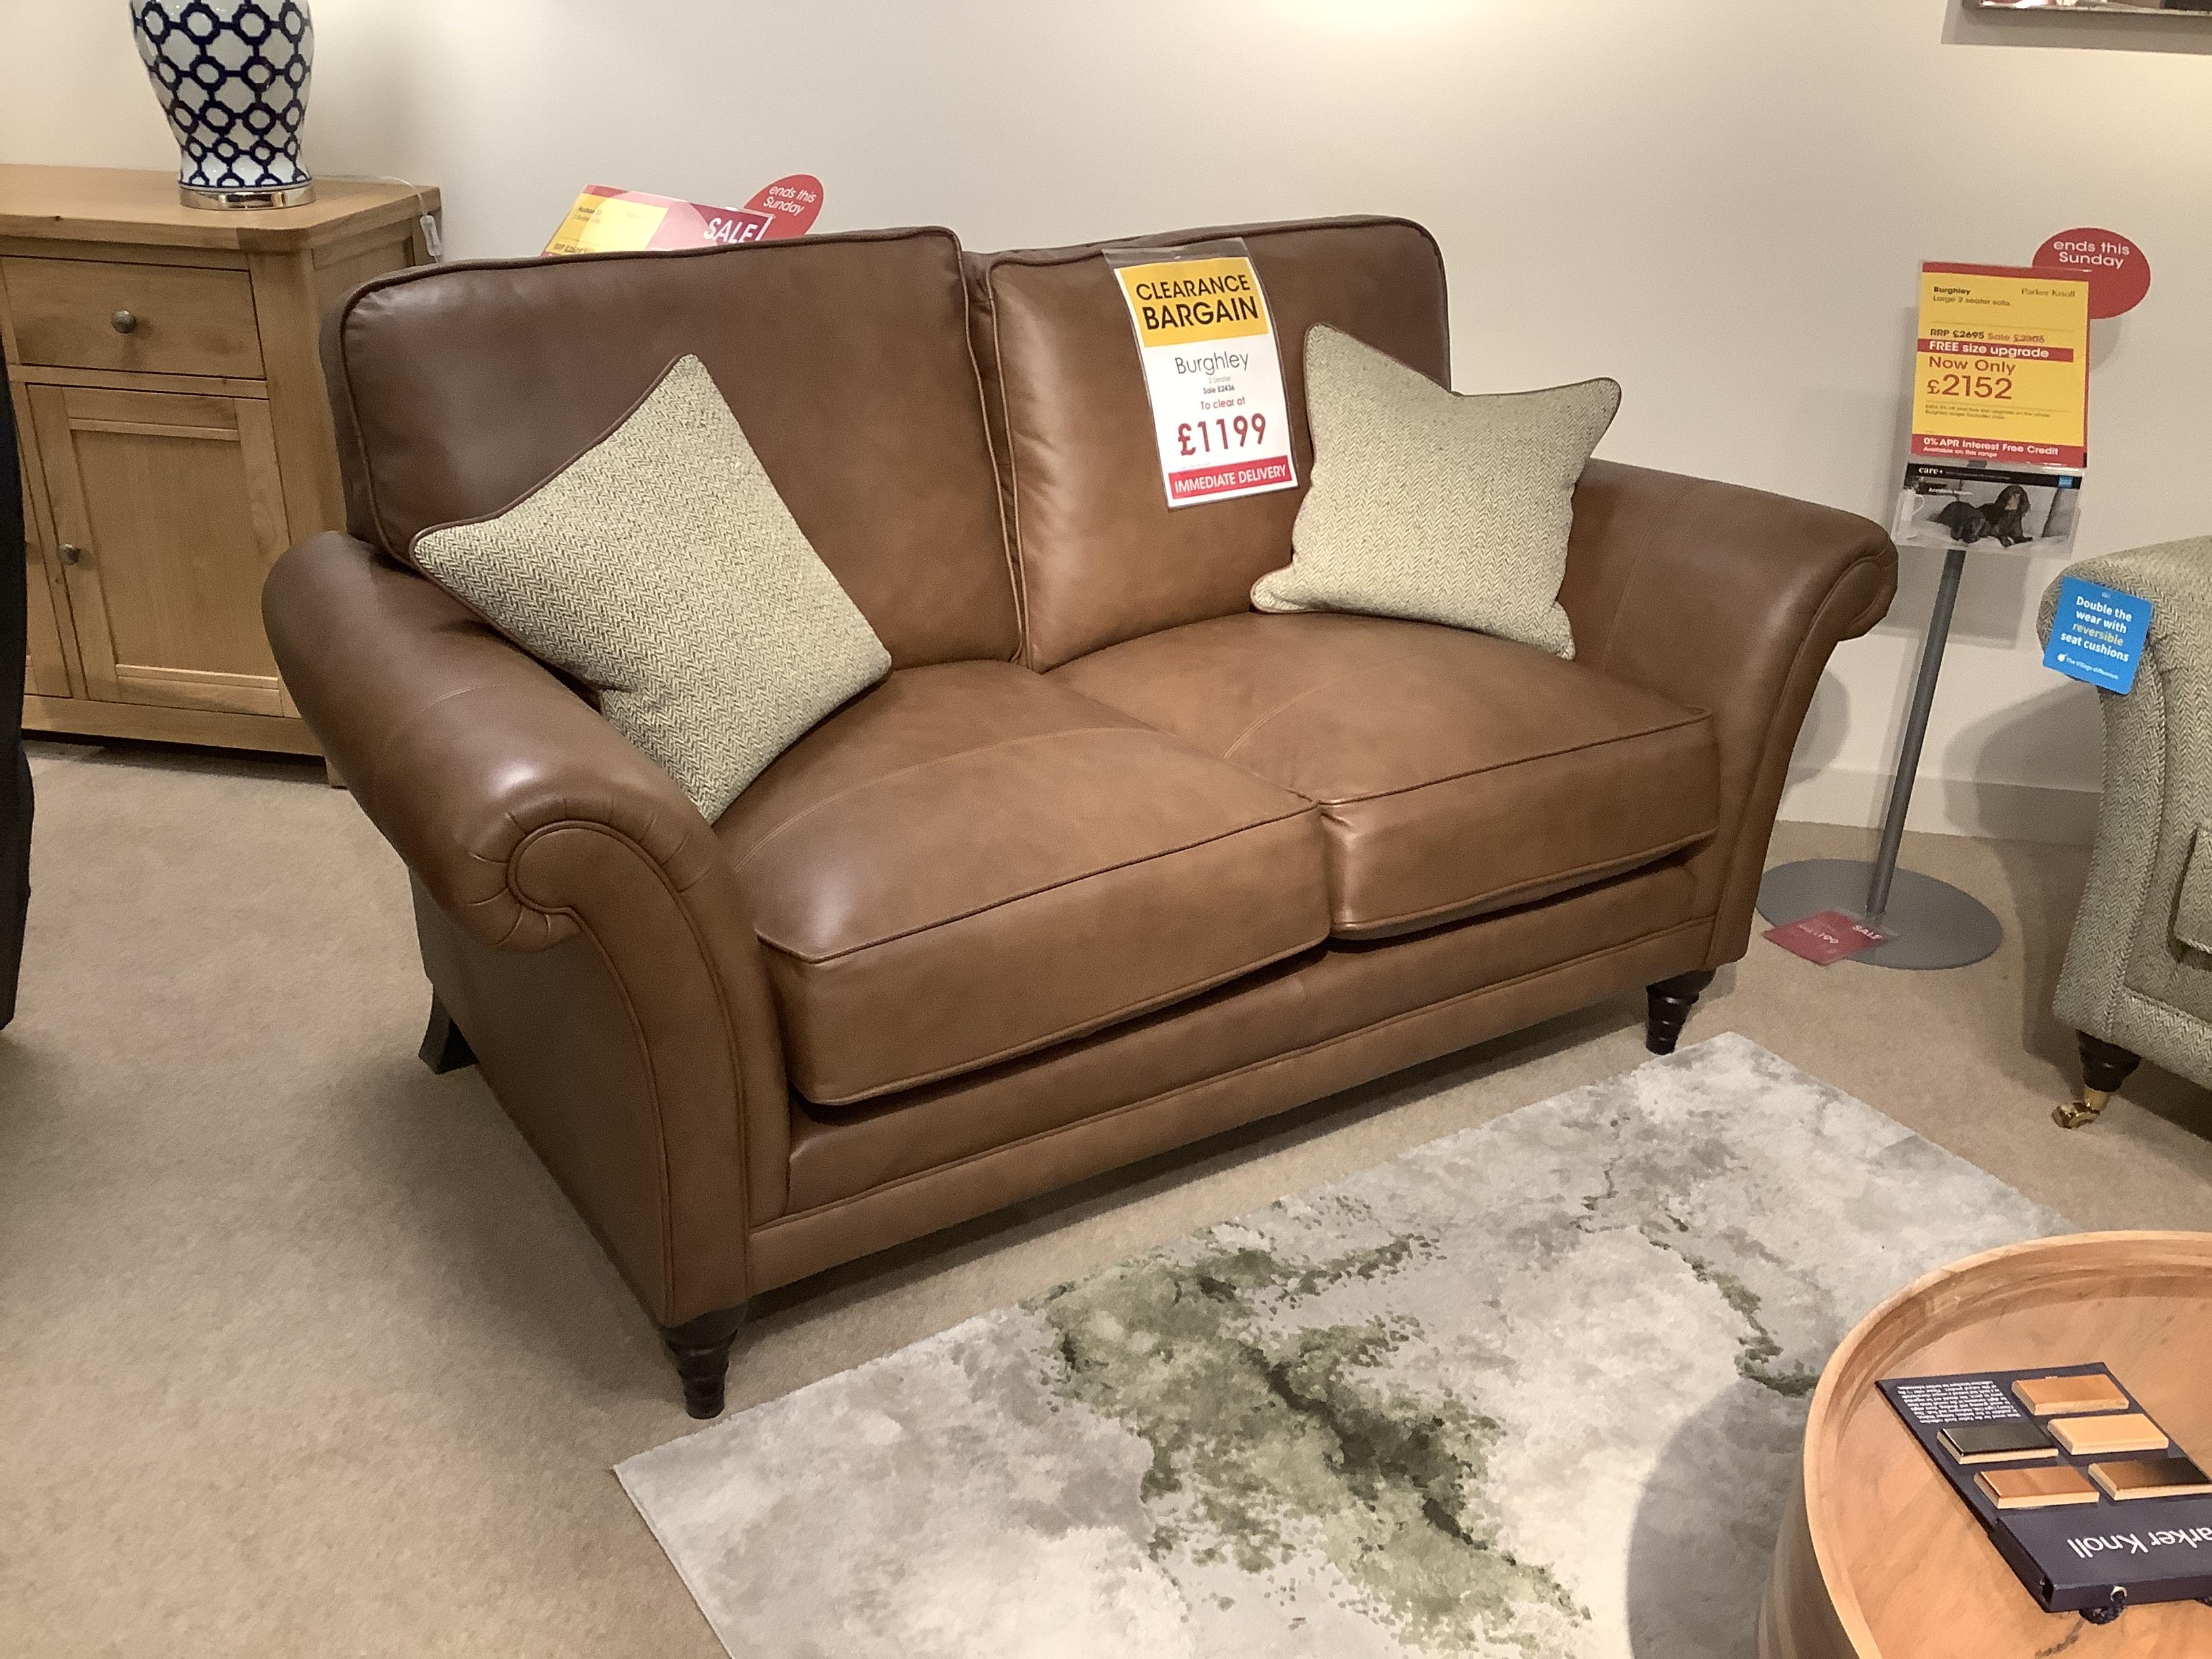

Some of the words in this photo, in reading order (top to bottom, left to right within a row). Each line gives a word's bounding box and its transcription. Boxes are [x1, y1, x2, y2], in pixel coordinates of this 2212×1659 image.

[769, 185, 796, 199] ends
[796, 189, 817, 203] this
[763, 196, 805, 216] Sunday
[703, 217, 758, 243] SALE
[2053, 239, 2095, 253] ends
[2100, 242, 2130, 255] this
[2059, 251, 2125, 270] Sunday
[1136, 274, 1250, 300] CLEARANCE
[1933, 286, 1971, 295] Burghley
[1933, 295, 1956, 303] Large
[1142, 295, 1259, 330] BARGAIN
[1930, 328, 1950, 337] RRP
[1952, 329, 1985, 339] £2695
[1988, 332, 2010, 341] Sale
[1929, 340, 1959, 353] FREE
[1962, 342, 1987, 354] size
[1990, 345, 2049, 359] upgrade
[1174, 351, 1249, 375] Burghley
[1929, 356, 1968, 370] Now
[1974, 359, 2016, 375] Only
[1927, 373, 2013, 400] £2152
[1200, 401, 1211, 410] To
[1213, 398, 1234, 409] clear
[1237, 396, 1246, 406] at
[1177, 413, 1267, 456] £1199
[1923, 437, 1938, 445] 0%
[1939, 438, 1960, 447] APR
[1962, 441, 1999, 451] Interest
[2003, 443, 2024, 453] Free
[2027, 445, 2059, 455] Credit
[1923, 446, 1953, 454] Available
[1174, 471, 1236, 493] IMMEDIATE
[1238, 464, 1287, 484] DELIVERY
[2076, 595, 2113, 615] Double
[2114, 607, 2133, 622] the
[2075, 610, 2102, 625] wear
[2103, 618, 2127, 634] with
[2072, 622, 2124, 647] reversible
[2060, 632, 2083, 647] seat
[2083, 639, 2130, 662] cushions
[2067, 1534, 2149, 1559] Knoll
[2148, 1526, 2212, 1549] arker
